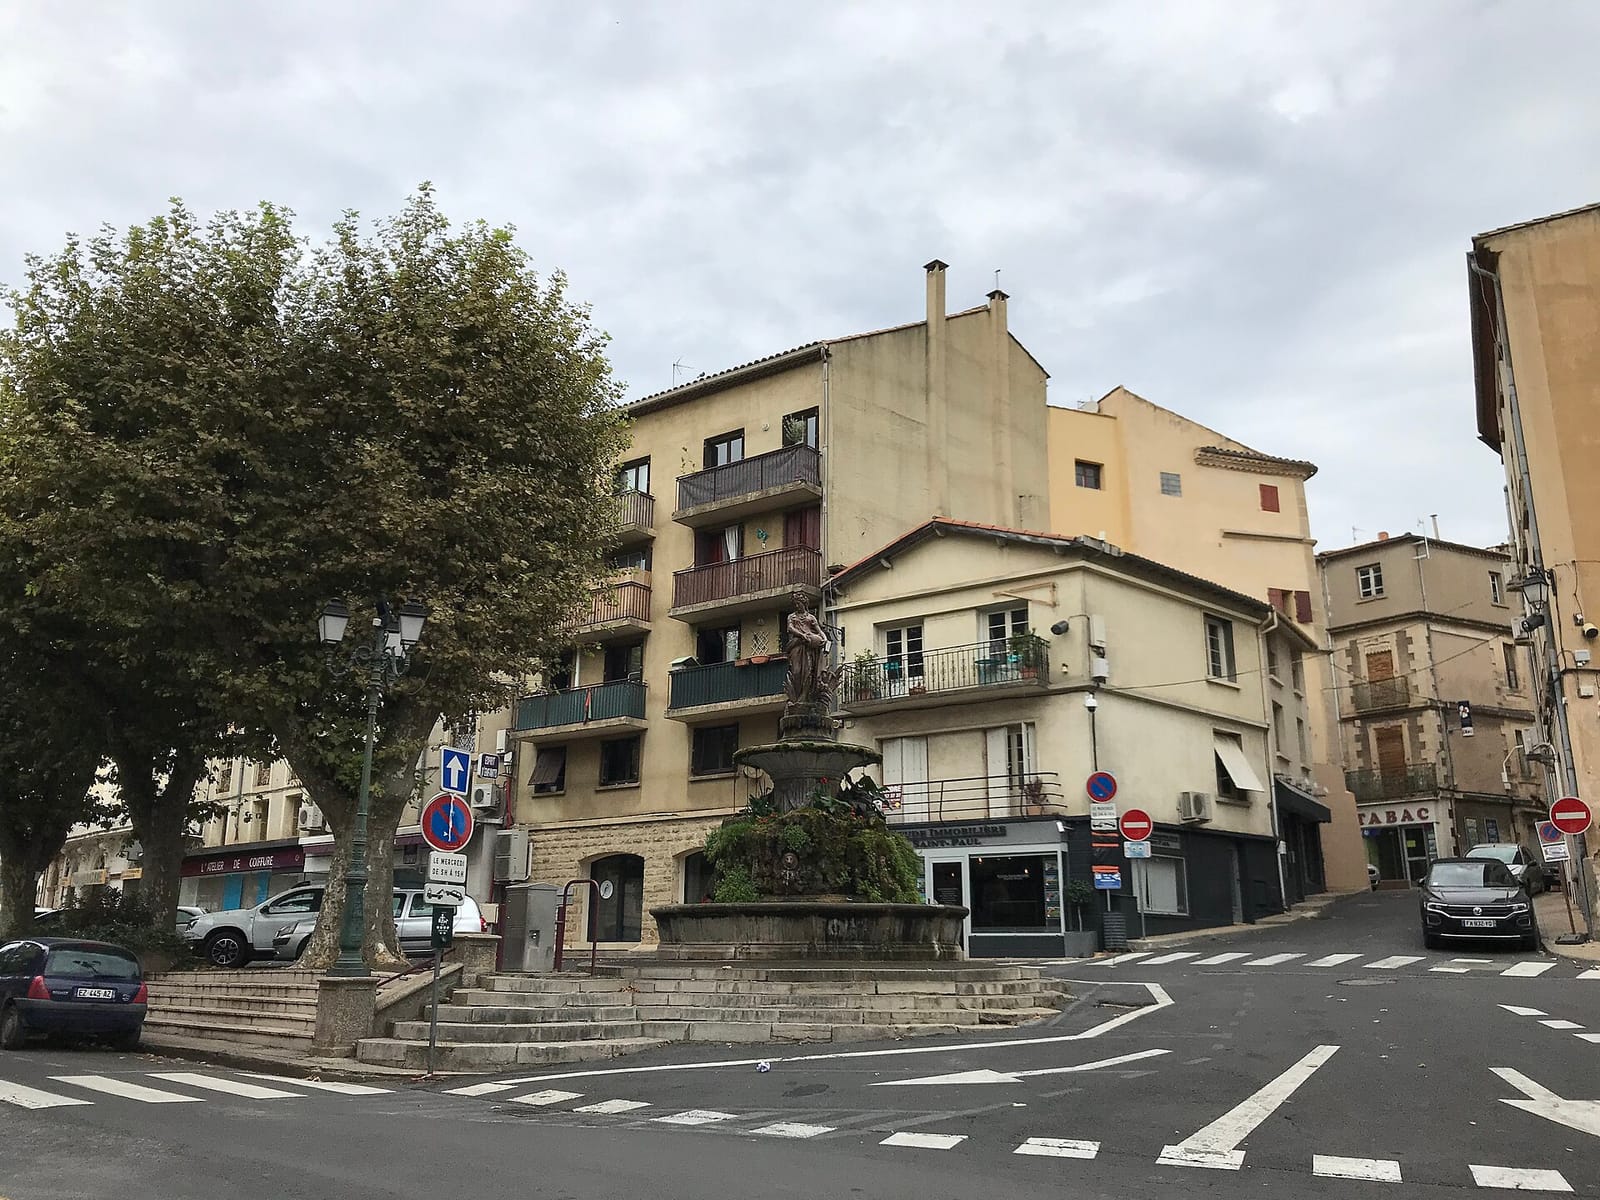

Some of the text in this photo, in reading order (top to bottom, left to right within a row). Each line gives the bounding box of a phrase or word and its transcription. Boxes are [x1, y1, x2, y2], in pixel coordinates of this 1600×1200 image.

[1358, 807, 1429, 825] TABAC
[201, 856, 273, 872] L'ATELIER DE COIFFURE
